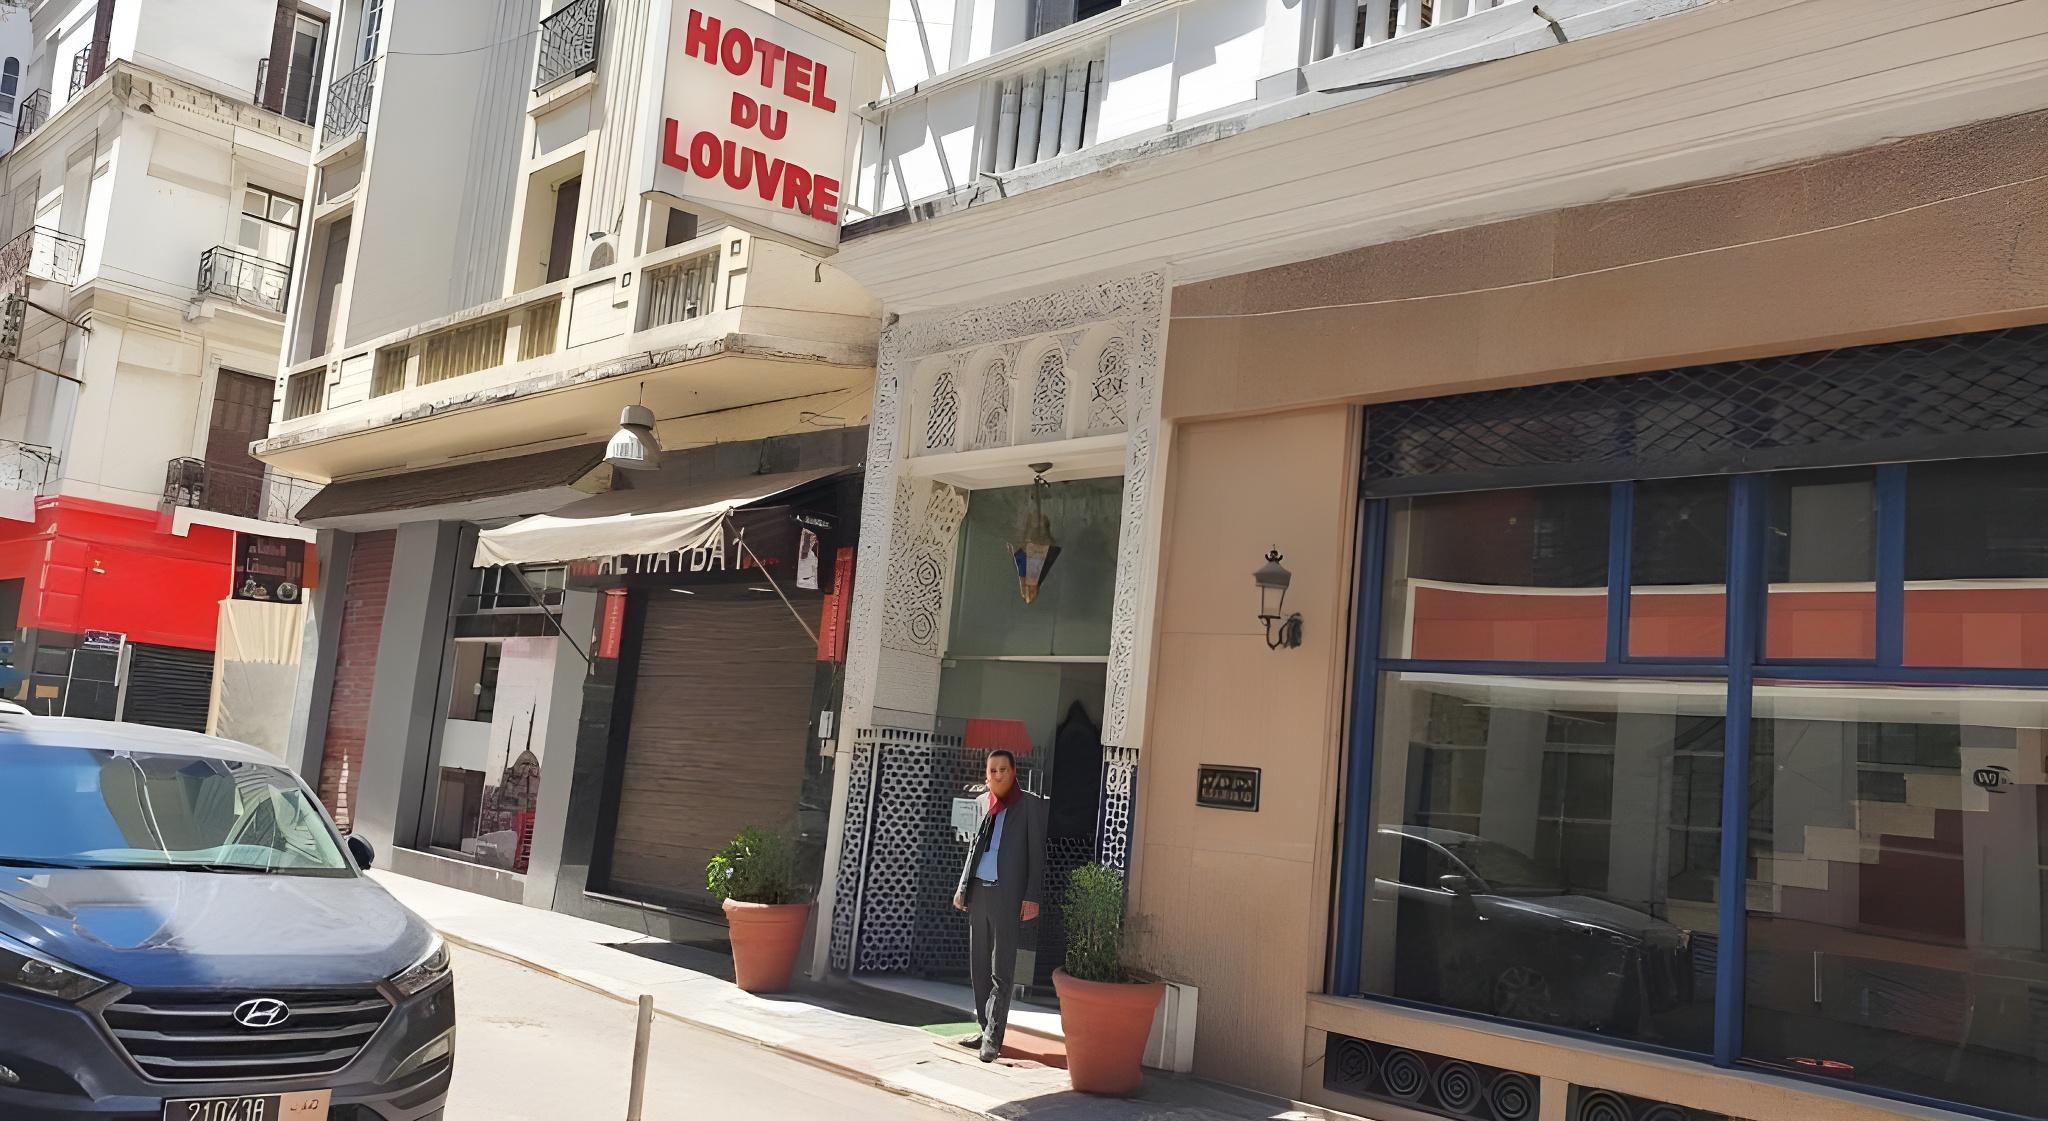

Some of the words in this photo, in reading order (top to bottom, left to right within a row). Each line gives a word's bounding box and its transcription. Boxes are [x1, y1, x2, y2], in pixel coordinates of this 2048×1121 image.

[685, 9, 836, 113] HOTEL
[731, 92, 788, 140] DU
[662, 118, 839, 225] LOUVRE
